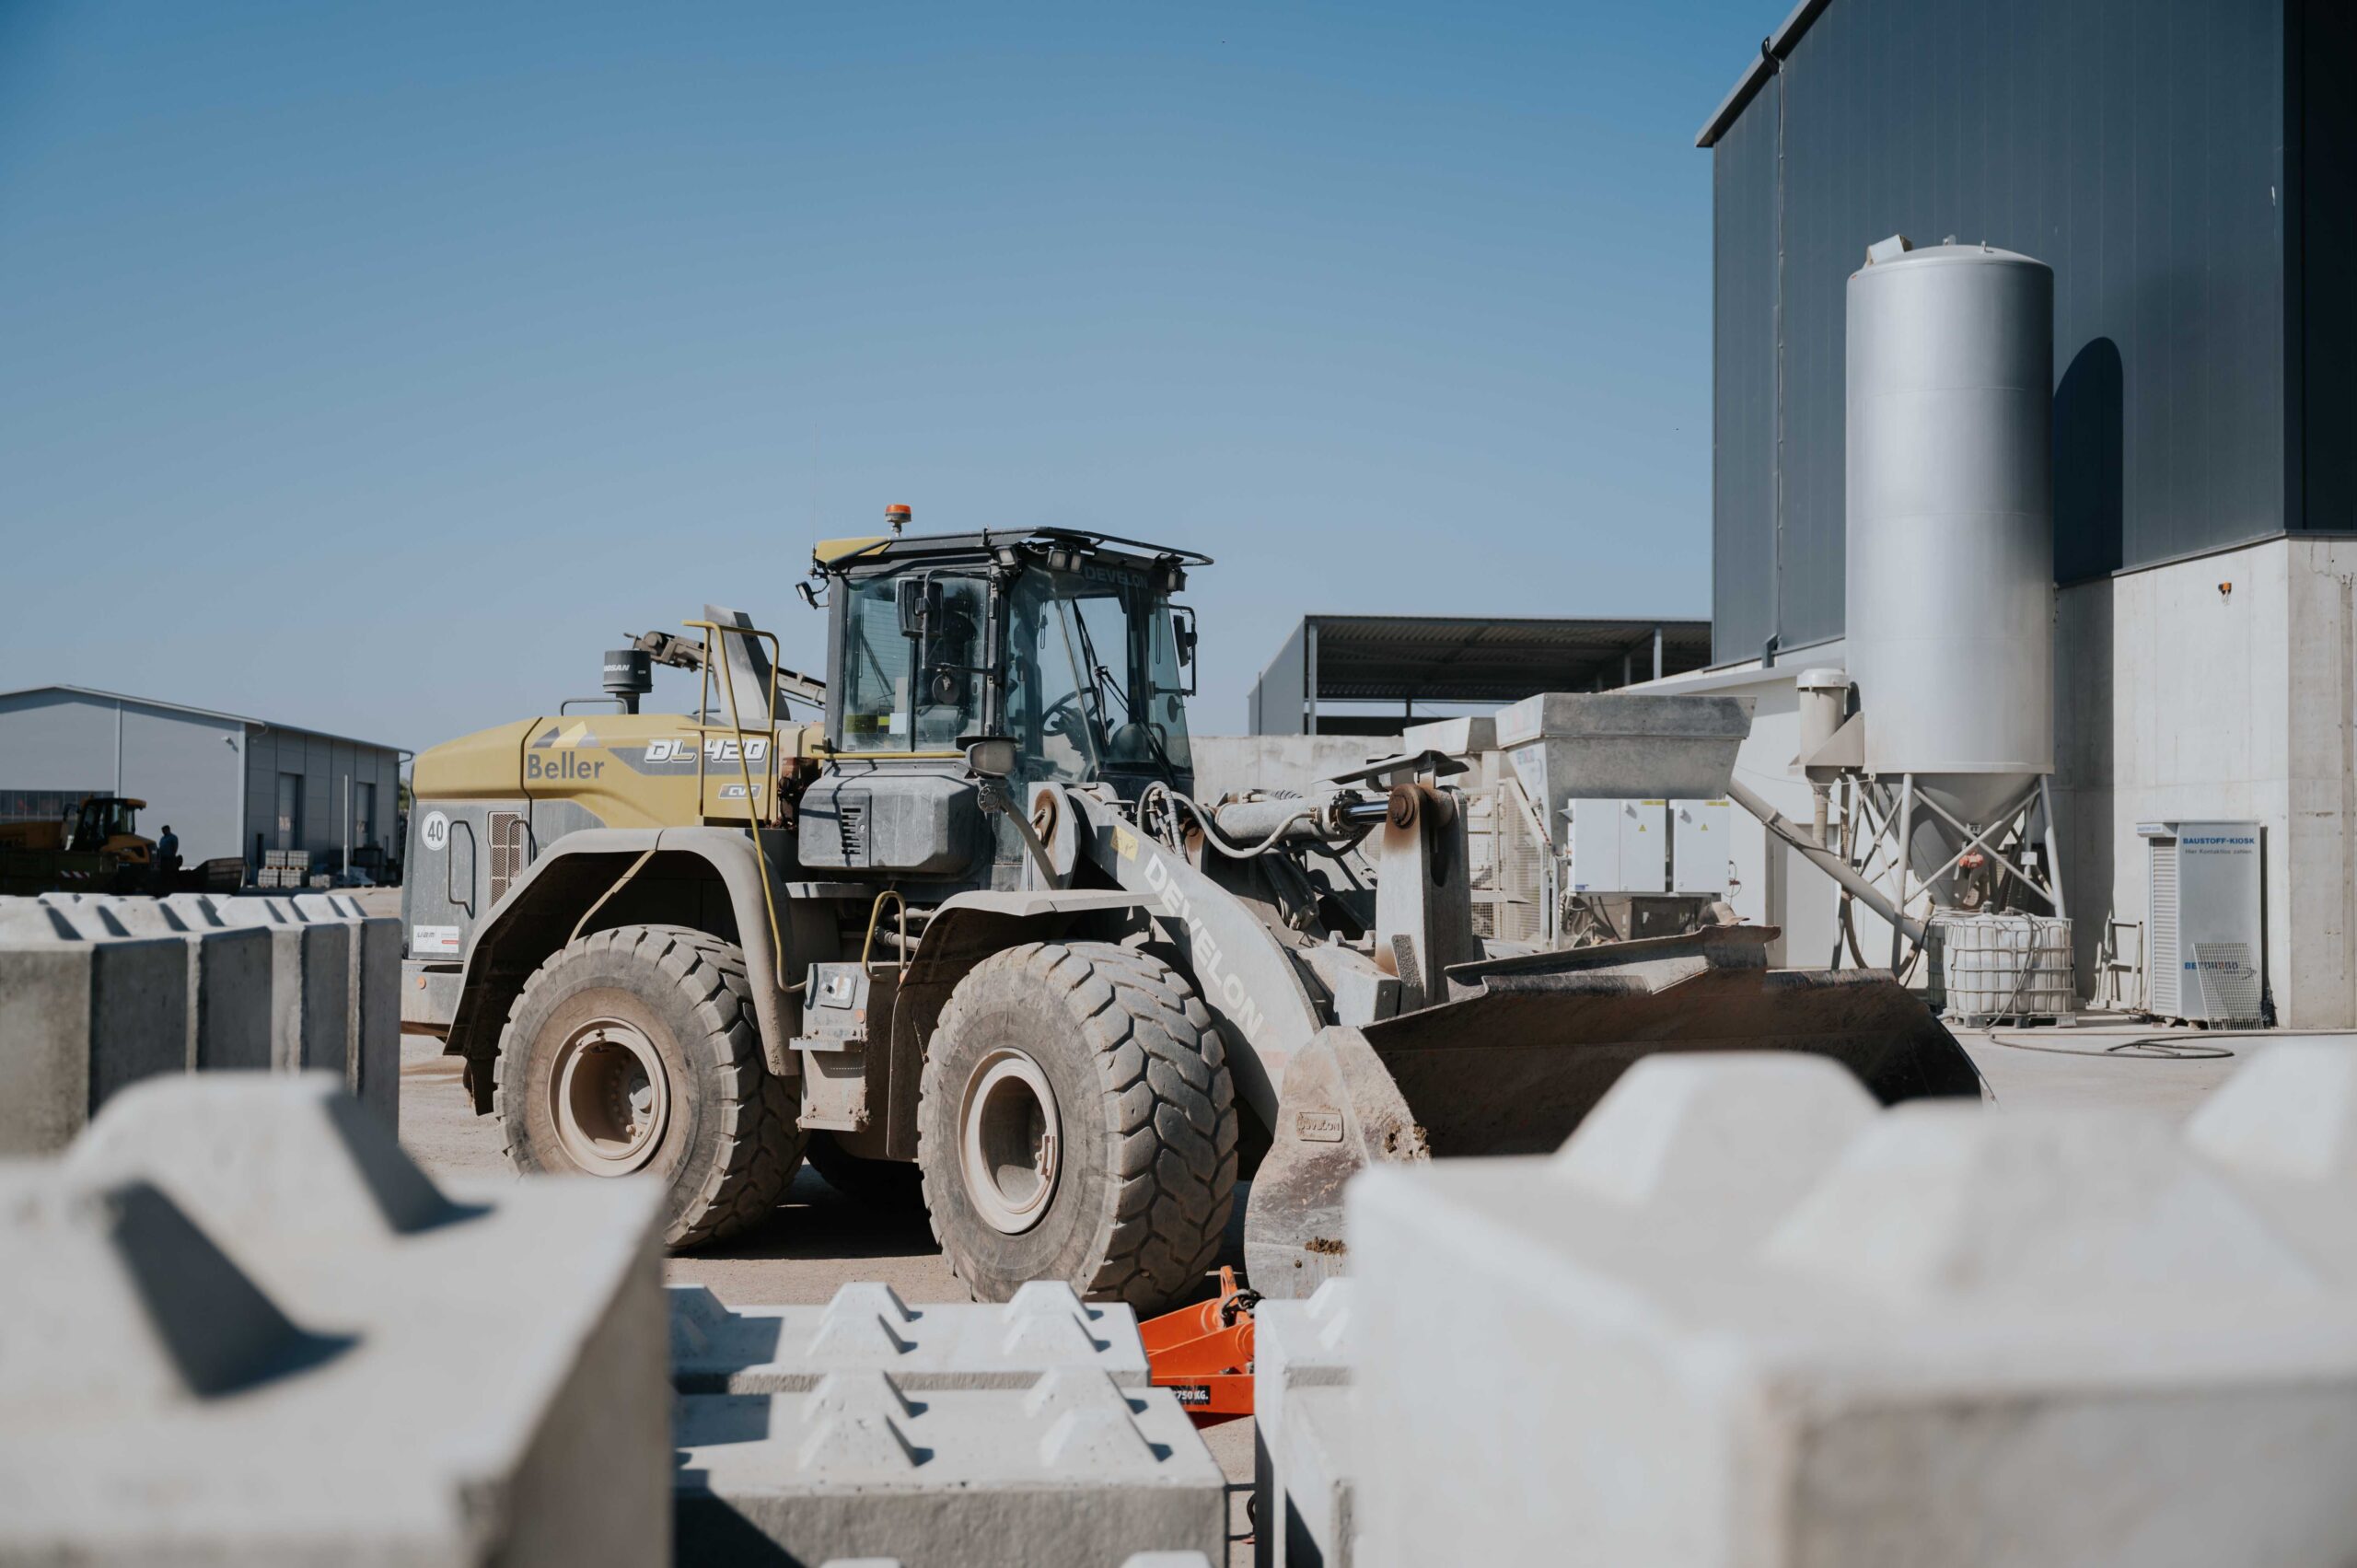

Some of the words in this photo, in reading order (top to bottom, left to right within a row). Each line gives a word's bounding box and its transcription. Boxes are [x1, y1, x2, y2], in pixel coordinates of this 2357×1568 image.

[644, 738, 697, 763] DL
[704, 738, 769, 762] 420
[528, 751, 605, 780] Beller
[427, 820, 444, 842] 40
[1144, 853, 1264, 1040] DEVELON
[1172, 1390, 1193, 1400] 750
